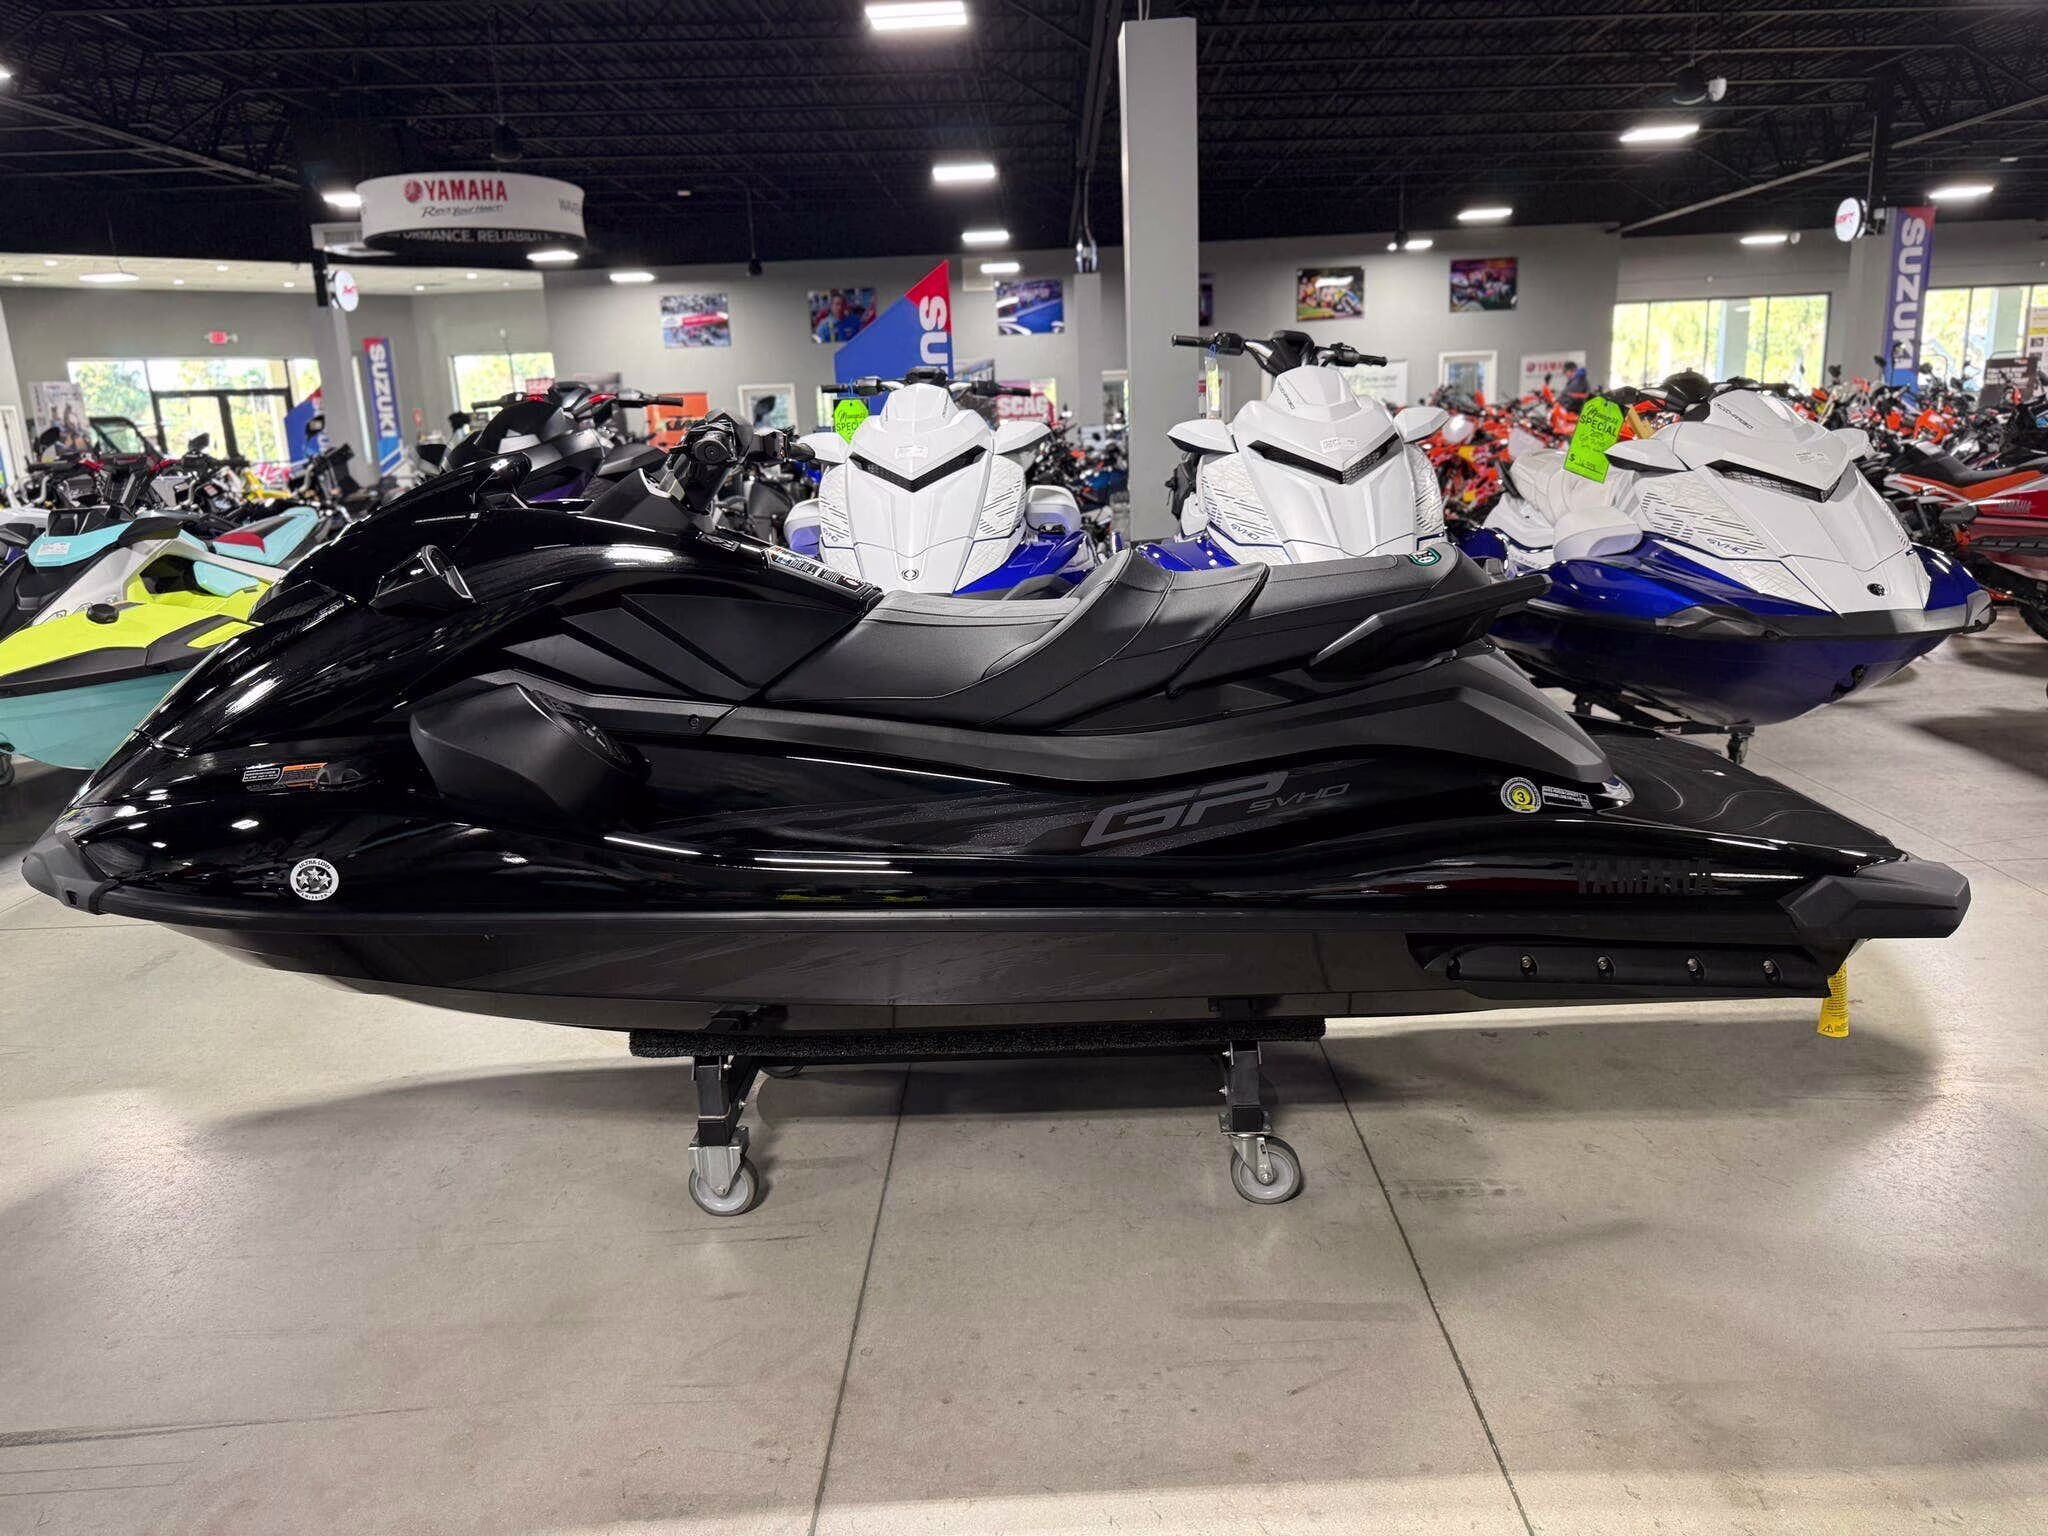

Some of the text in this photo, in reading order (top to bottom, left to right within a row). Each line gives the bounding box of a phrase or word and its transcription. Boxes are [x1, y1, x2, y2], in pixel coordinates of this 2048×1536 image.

[424, 179, 508, 201] YAMAHA
[1892, 217, 1926, 370] SUZUKI
[369, 343, 397, 438] SUZUKI
[997, 395, 1048, 416] SCAG
[836, 421, 859, 432] SPECI
[1579, 414, 1616, 438] SPECIAL
[1706, 536, 1749, 556] SVHO
[1516, 791, 1526, 803] 3
[1081, 771, 1350, 847] GP SVHO
